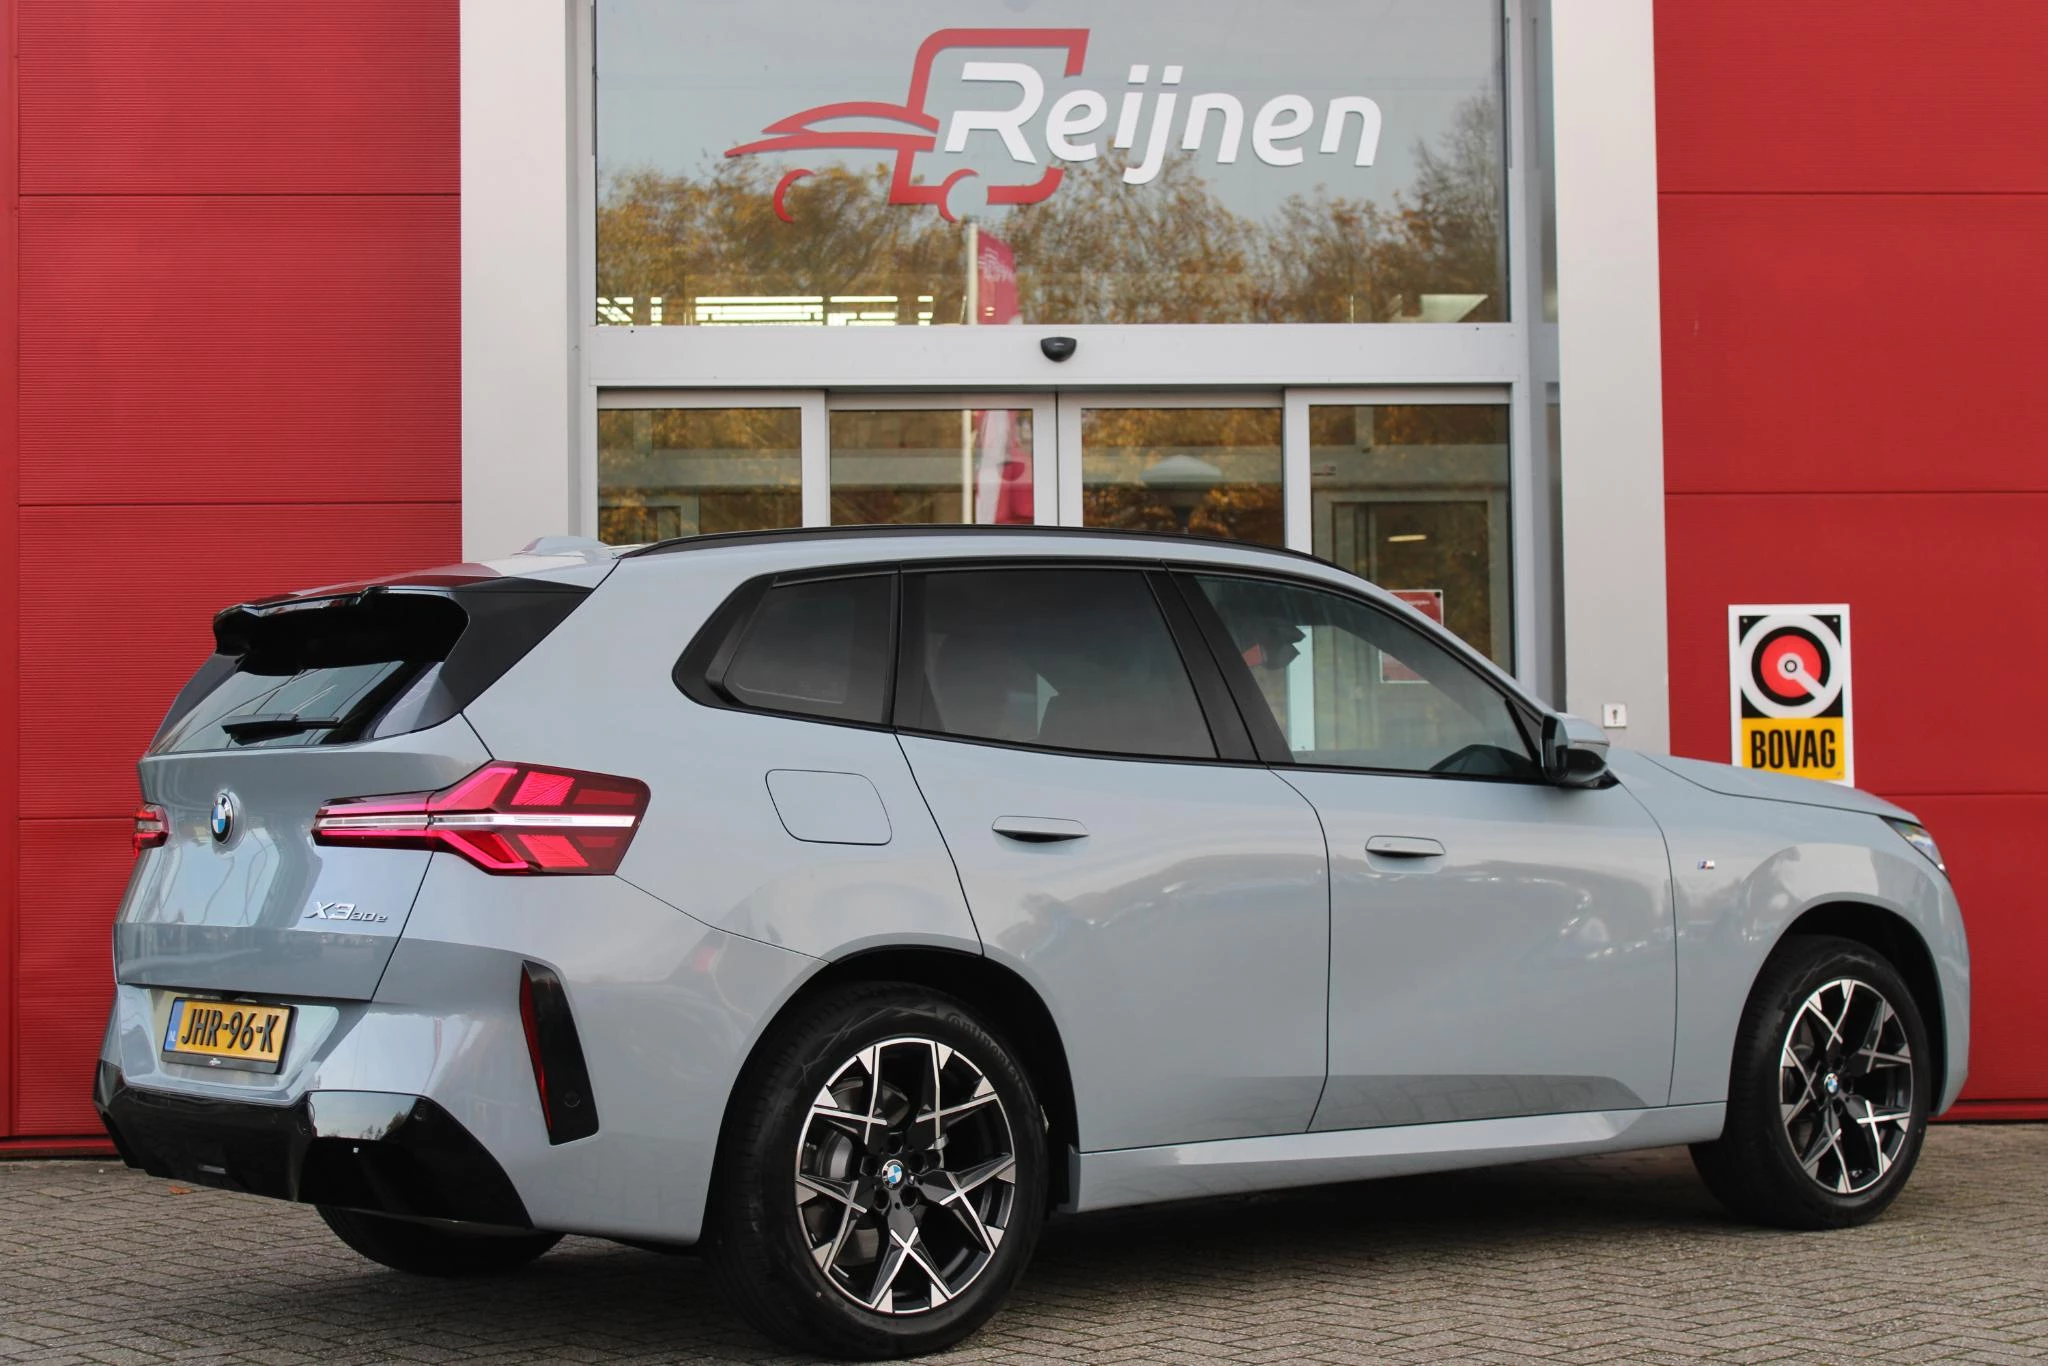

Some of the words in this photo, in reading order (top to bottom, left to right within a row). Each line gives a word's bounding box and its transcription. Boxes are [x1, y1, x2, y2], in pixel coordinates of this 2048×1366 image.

[945, 62, 1382, 185] Reijnen
[1751, 729, 1835, 768] BOVAG
[181, 1008, 279, 1053] JHR-96-K
